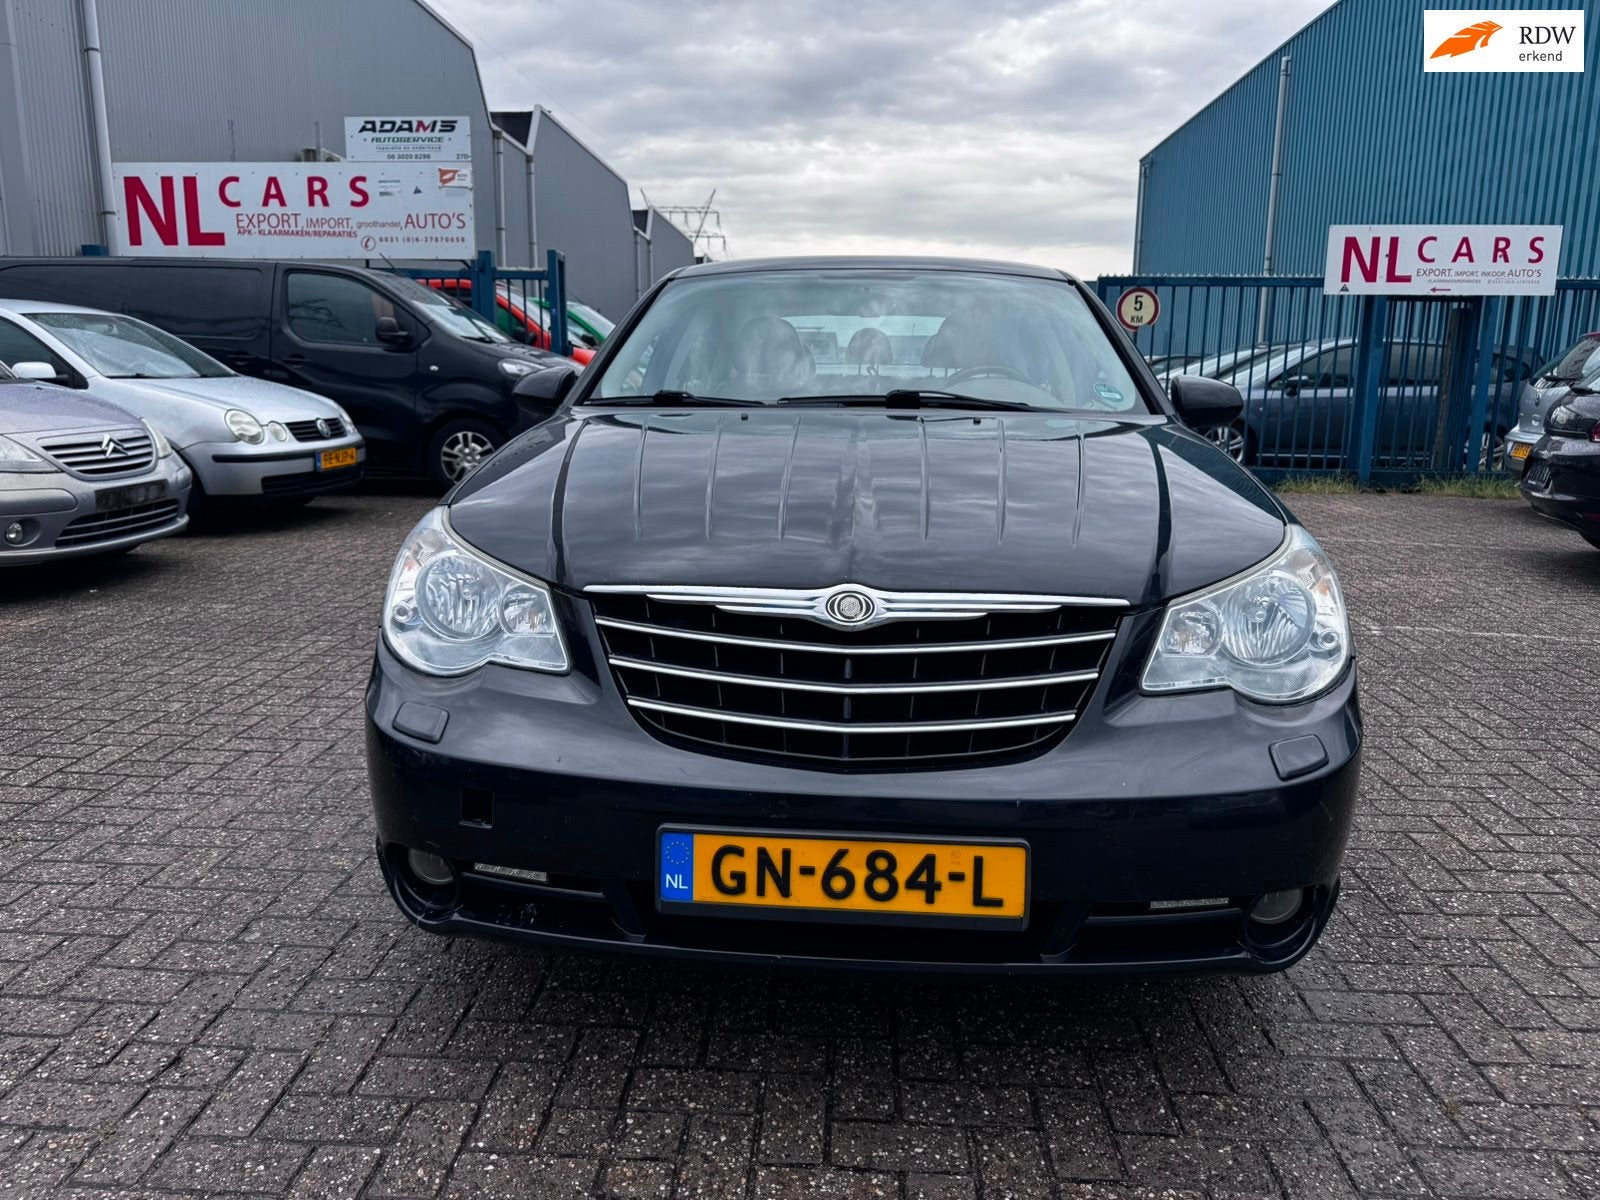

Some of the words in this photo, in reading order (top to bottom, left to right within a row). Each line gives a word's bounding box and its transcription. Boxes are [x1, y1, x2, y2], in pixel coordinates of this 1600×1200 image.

[358, 120, 458, 133] ADAMS
[123, 176, 226, 246] NL
[218, 176, 370, 208] CARS
[306, 217, 354, 229] IMPORT,
[404, 213, 466, 229] AUTO'S
[1340, 236, 1412, 283] NL
[1417, 236, 1545, 264] CARS
[1507, 268, 1542, 278] AUTO'S
[1134, 295, 1143, 311] 5
[1131, 315, 1143, 324] KM
[665, 873, 689, 889] NL
[711, 844, 1004, 908] GN-684-L
